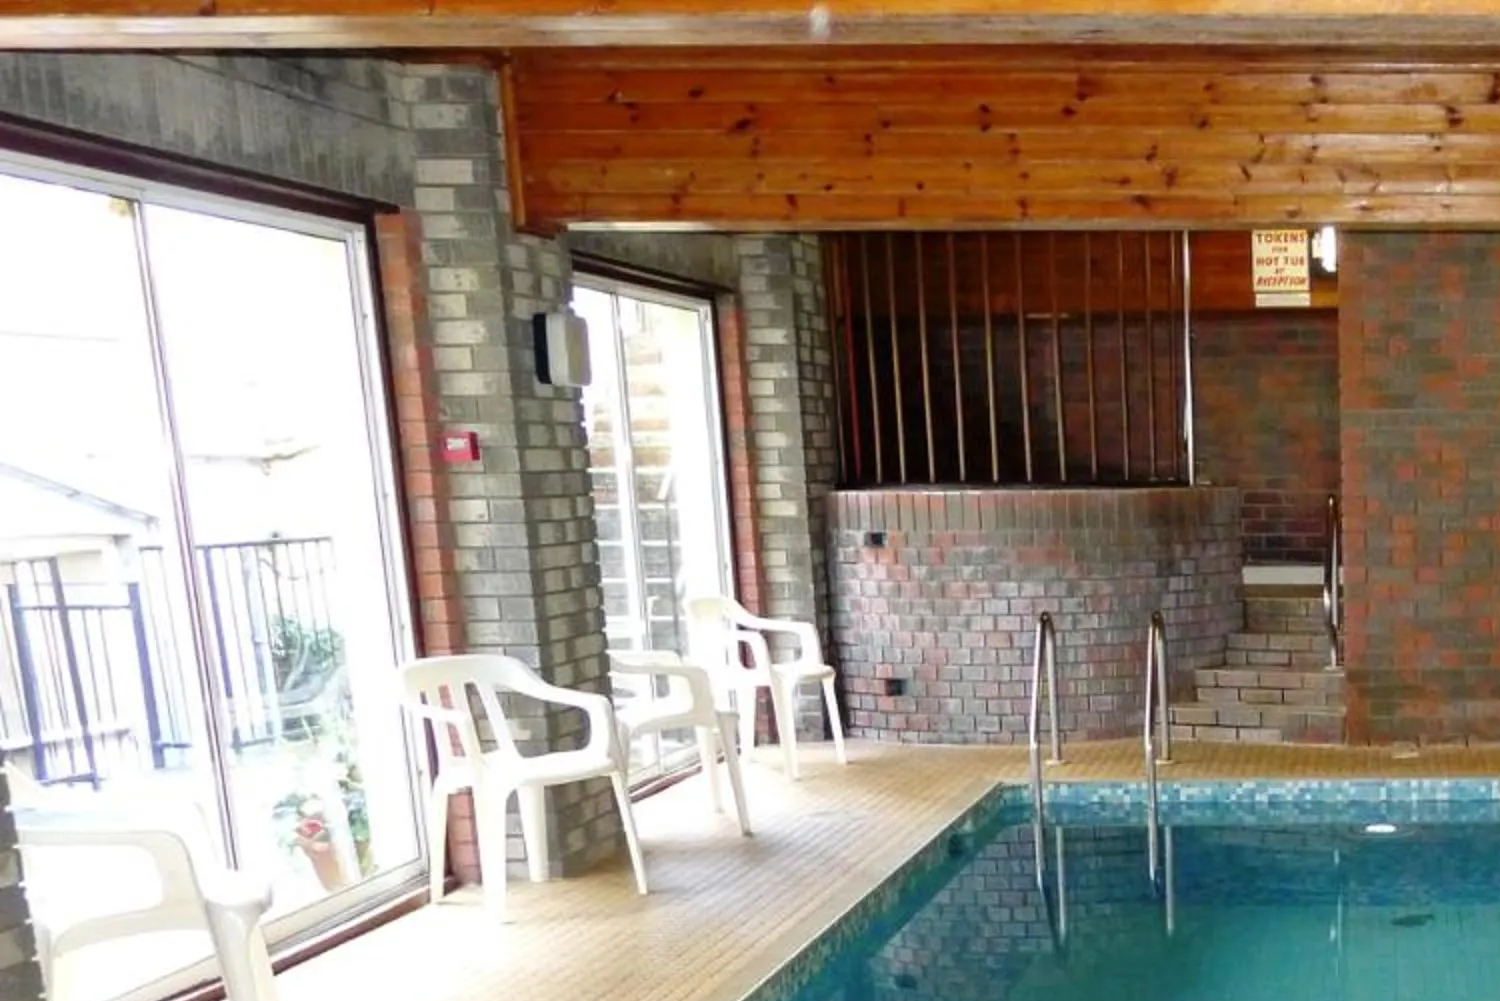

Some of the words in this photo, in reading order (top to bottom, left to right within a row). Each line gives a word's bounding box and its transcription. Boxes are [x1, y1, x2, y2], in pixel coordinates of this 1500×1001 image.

[1256, 232, 1305, 244] TOKENS
[1256, 255, 1280, 267] HOT
[1283, 255, 1305, 267] TUB
[1256, 275, 1306, 287] RECEPTION
